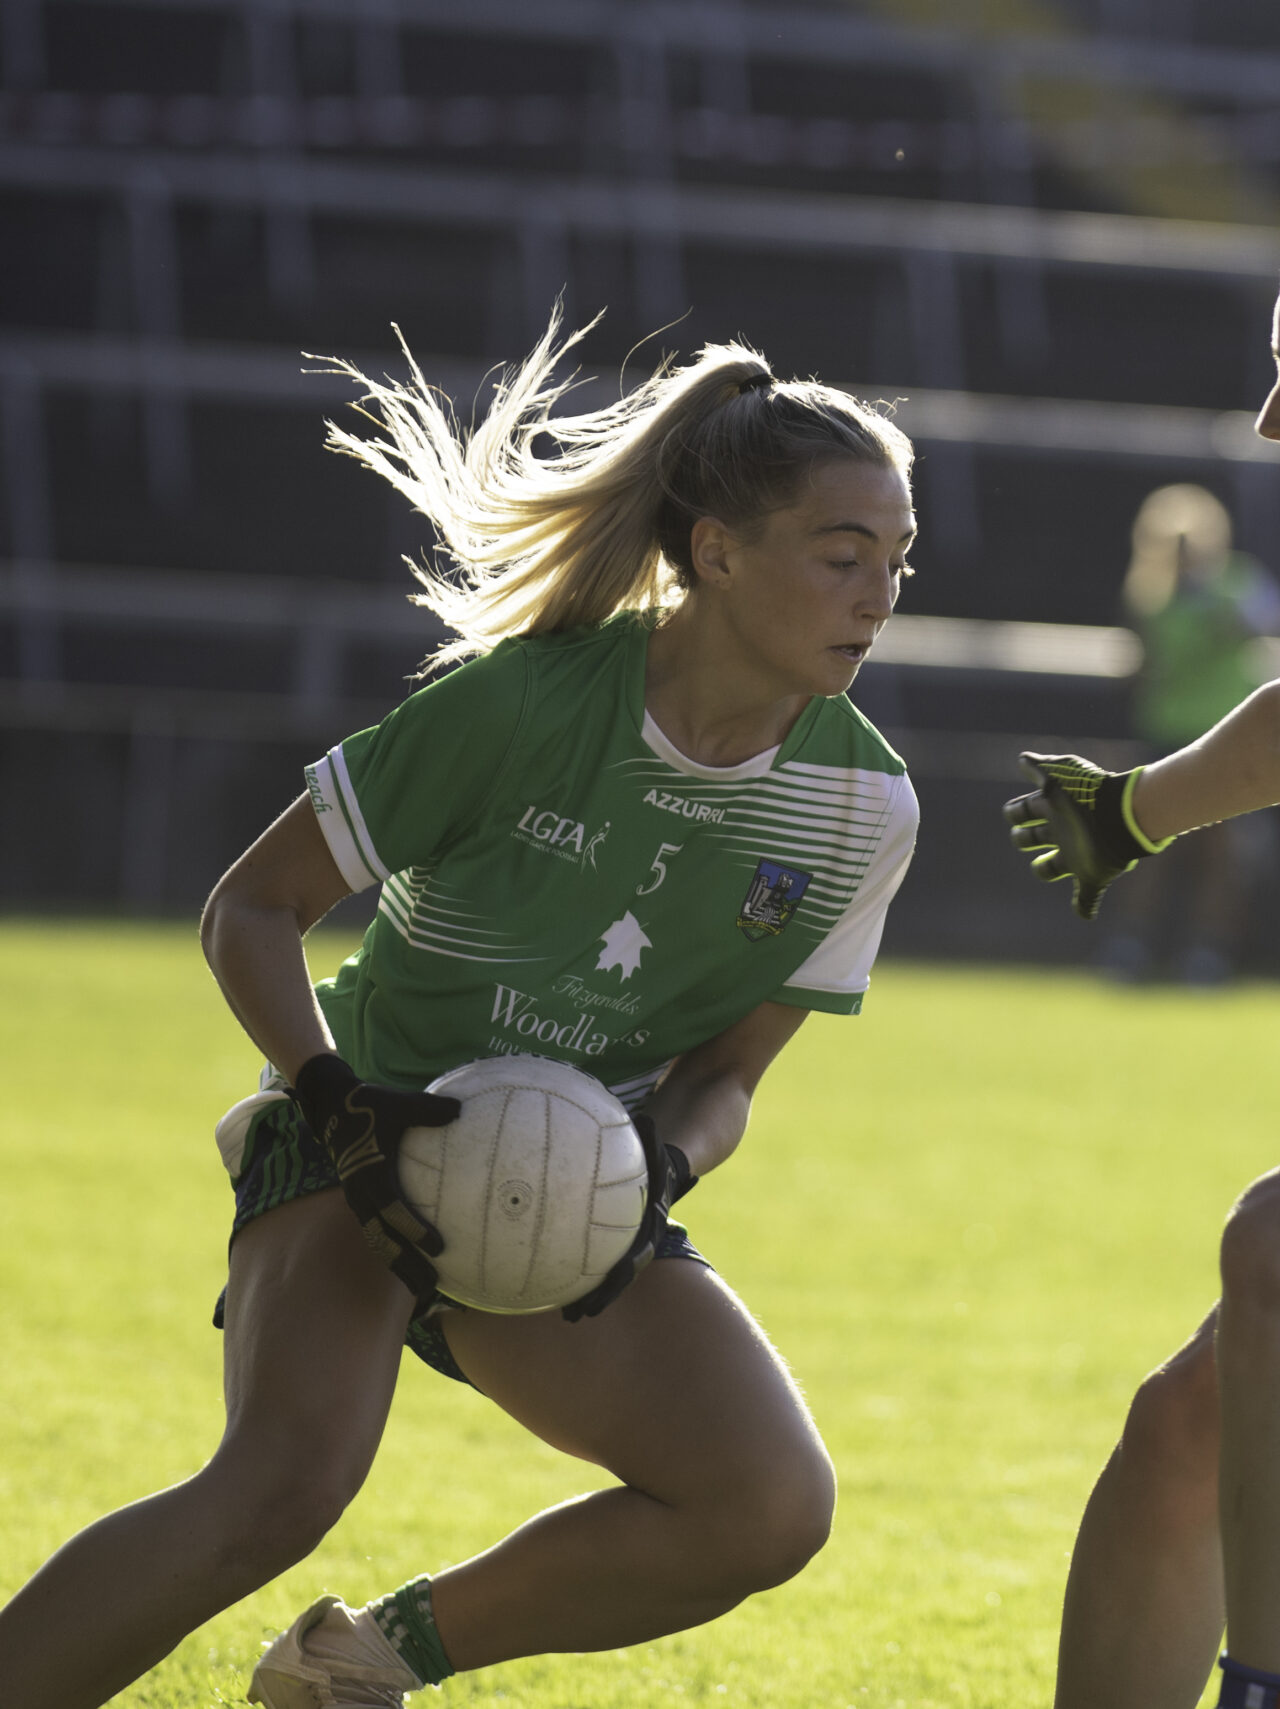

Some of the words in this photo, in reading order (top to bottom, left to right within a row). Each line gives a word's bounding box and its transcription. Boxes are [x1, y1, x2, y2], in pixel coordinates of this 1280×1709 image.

[517, 806, 584, 853] LGFA
[643, 789, 725, 824] AZZURRI
[636, 843, 684, 895] 5
[491, 982, 651, 1056] Woodlas
